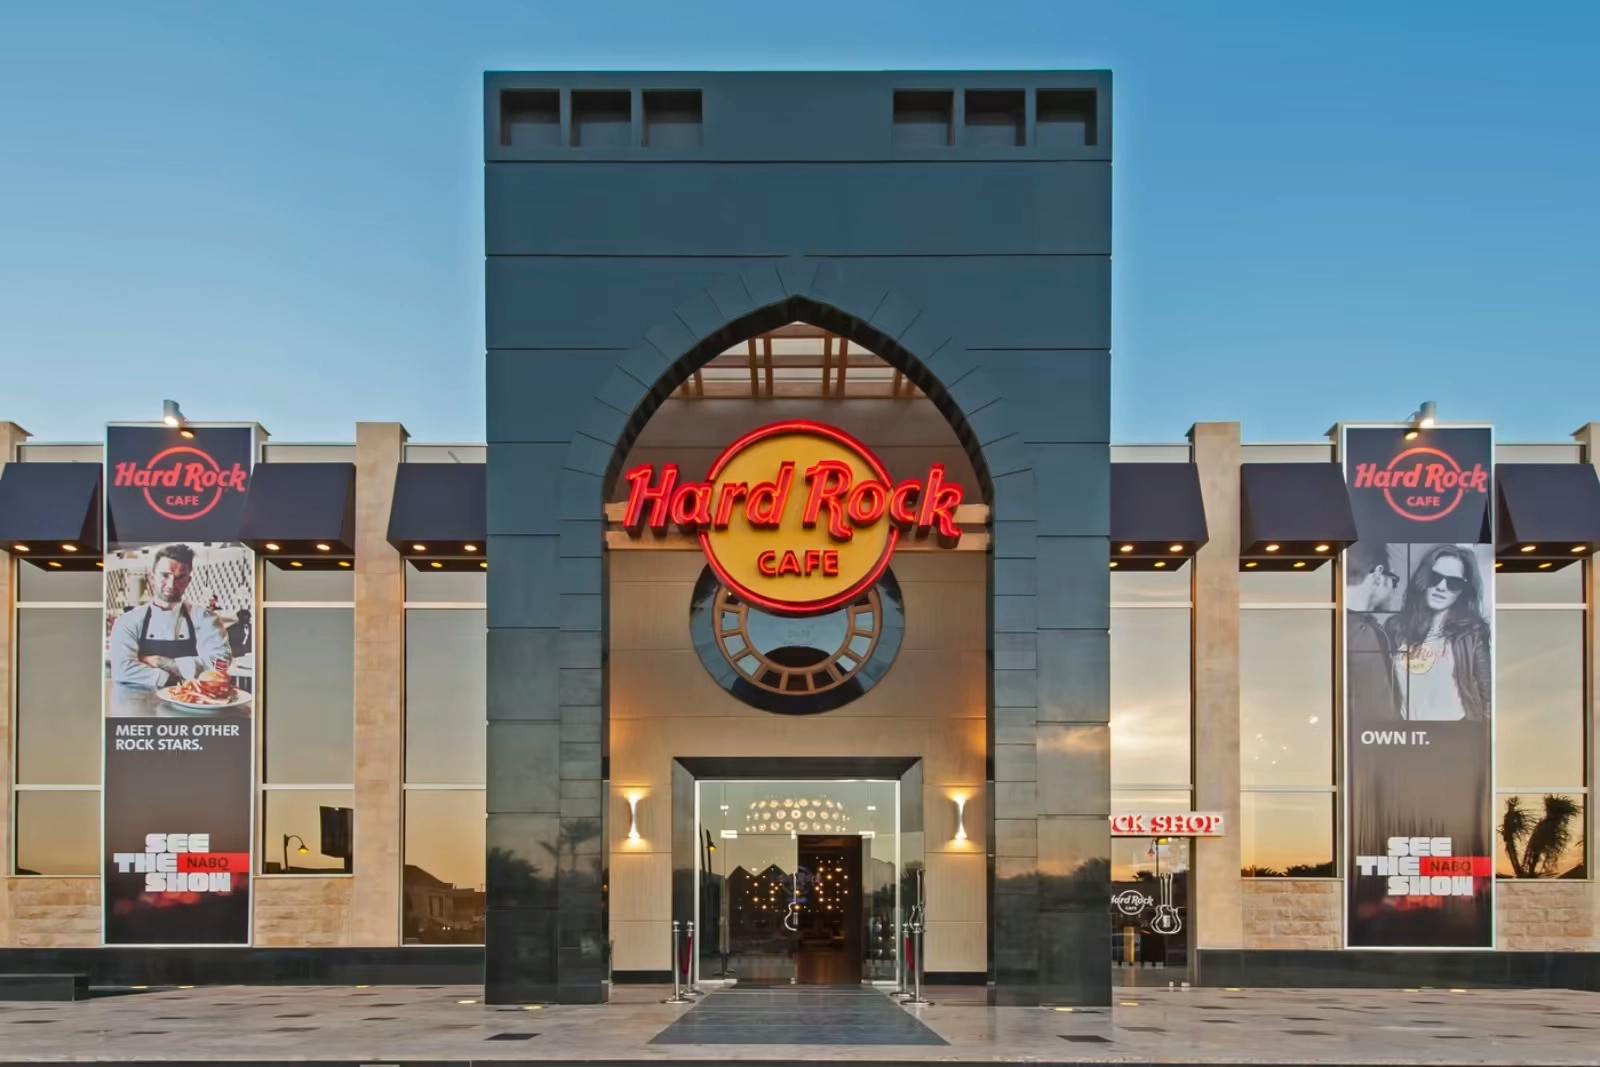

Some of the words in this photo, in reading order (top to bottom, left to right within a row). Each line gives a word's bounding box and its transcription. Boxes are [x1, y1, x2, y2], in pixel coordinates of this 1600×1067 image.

[114, 462, 182, 487] Hard
[184, 462, 248, 492] Rock
[1354, 463, 1423, 488] Hard
[1424, 463, 1488, 493] Rock
[166, 495, 200, 506] CAFE
[624, 460, 795, 534] Hard
[802, 460, 964, 542] Rock
[1406, 496, 1441, 507] CAFE
[758, 550, 839, 577] CAFE
[115, 724, 152, 737] MEET
[156, 724, 188, 737] OUR
[192, 724, 240, 737] OTHER
[1361, 731, 1407, 745] OWN
[1411, 731, 1430, 745] IT.
[116, 739, 154, 750] ROCK
[158, 739, 203, 750] STARS.
[1151, 815, 1223, 833] SHOP
[145, 833, 210, 853] SEE
[1387, 837, 1452, 857] SEE
[113, 853, 177, 873] THE
[186, 857, 229, 871] NABQ
[1356, 856, 1420, 876] THE
[1430, 860, 1472, 875] NABQ
[145, 872, 231, 892] SHOW
[1387, 876, 1474, 896] SHOW
